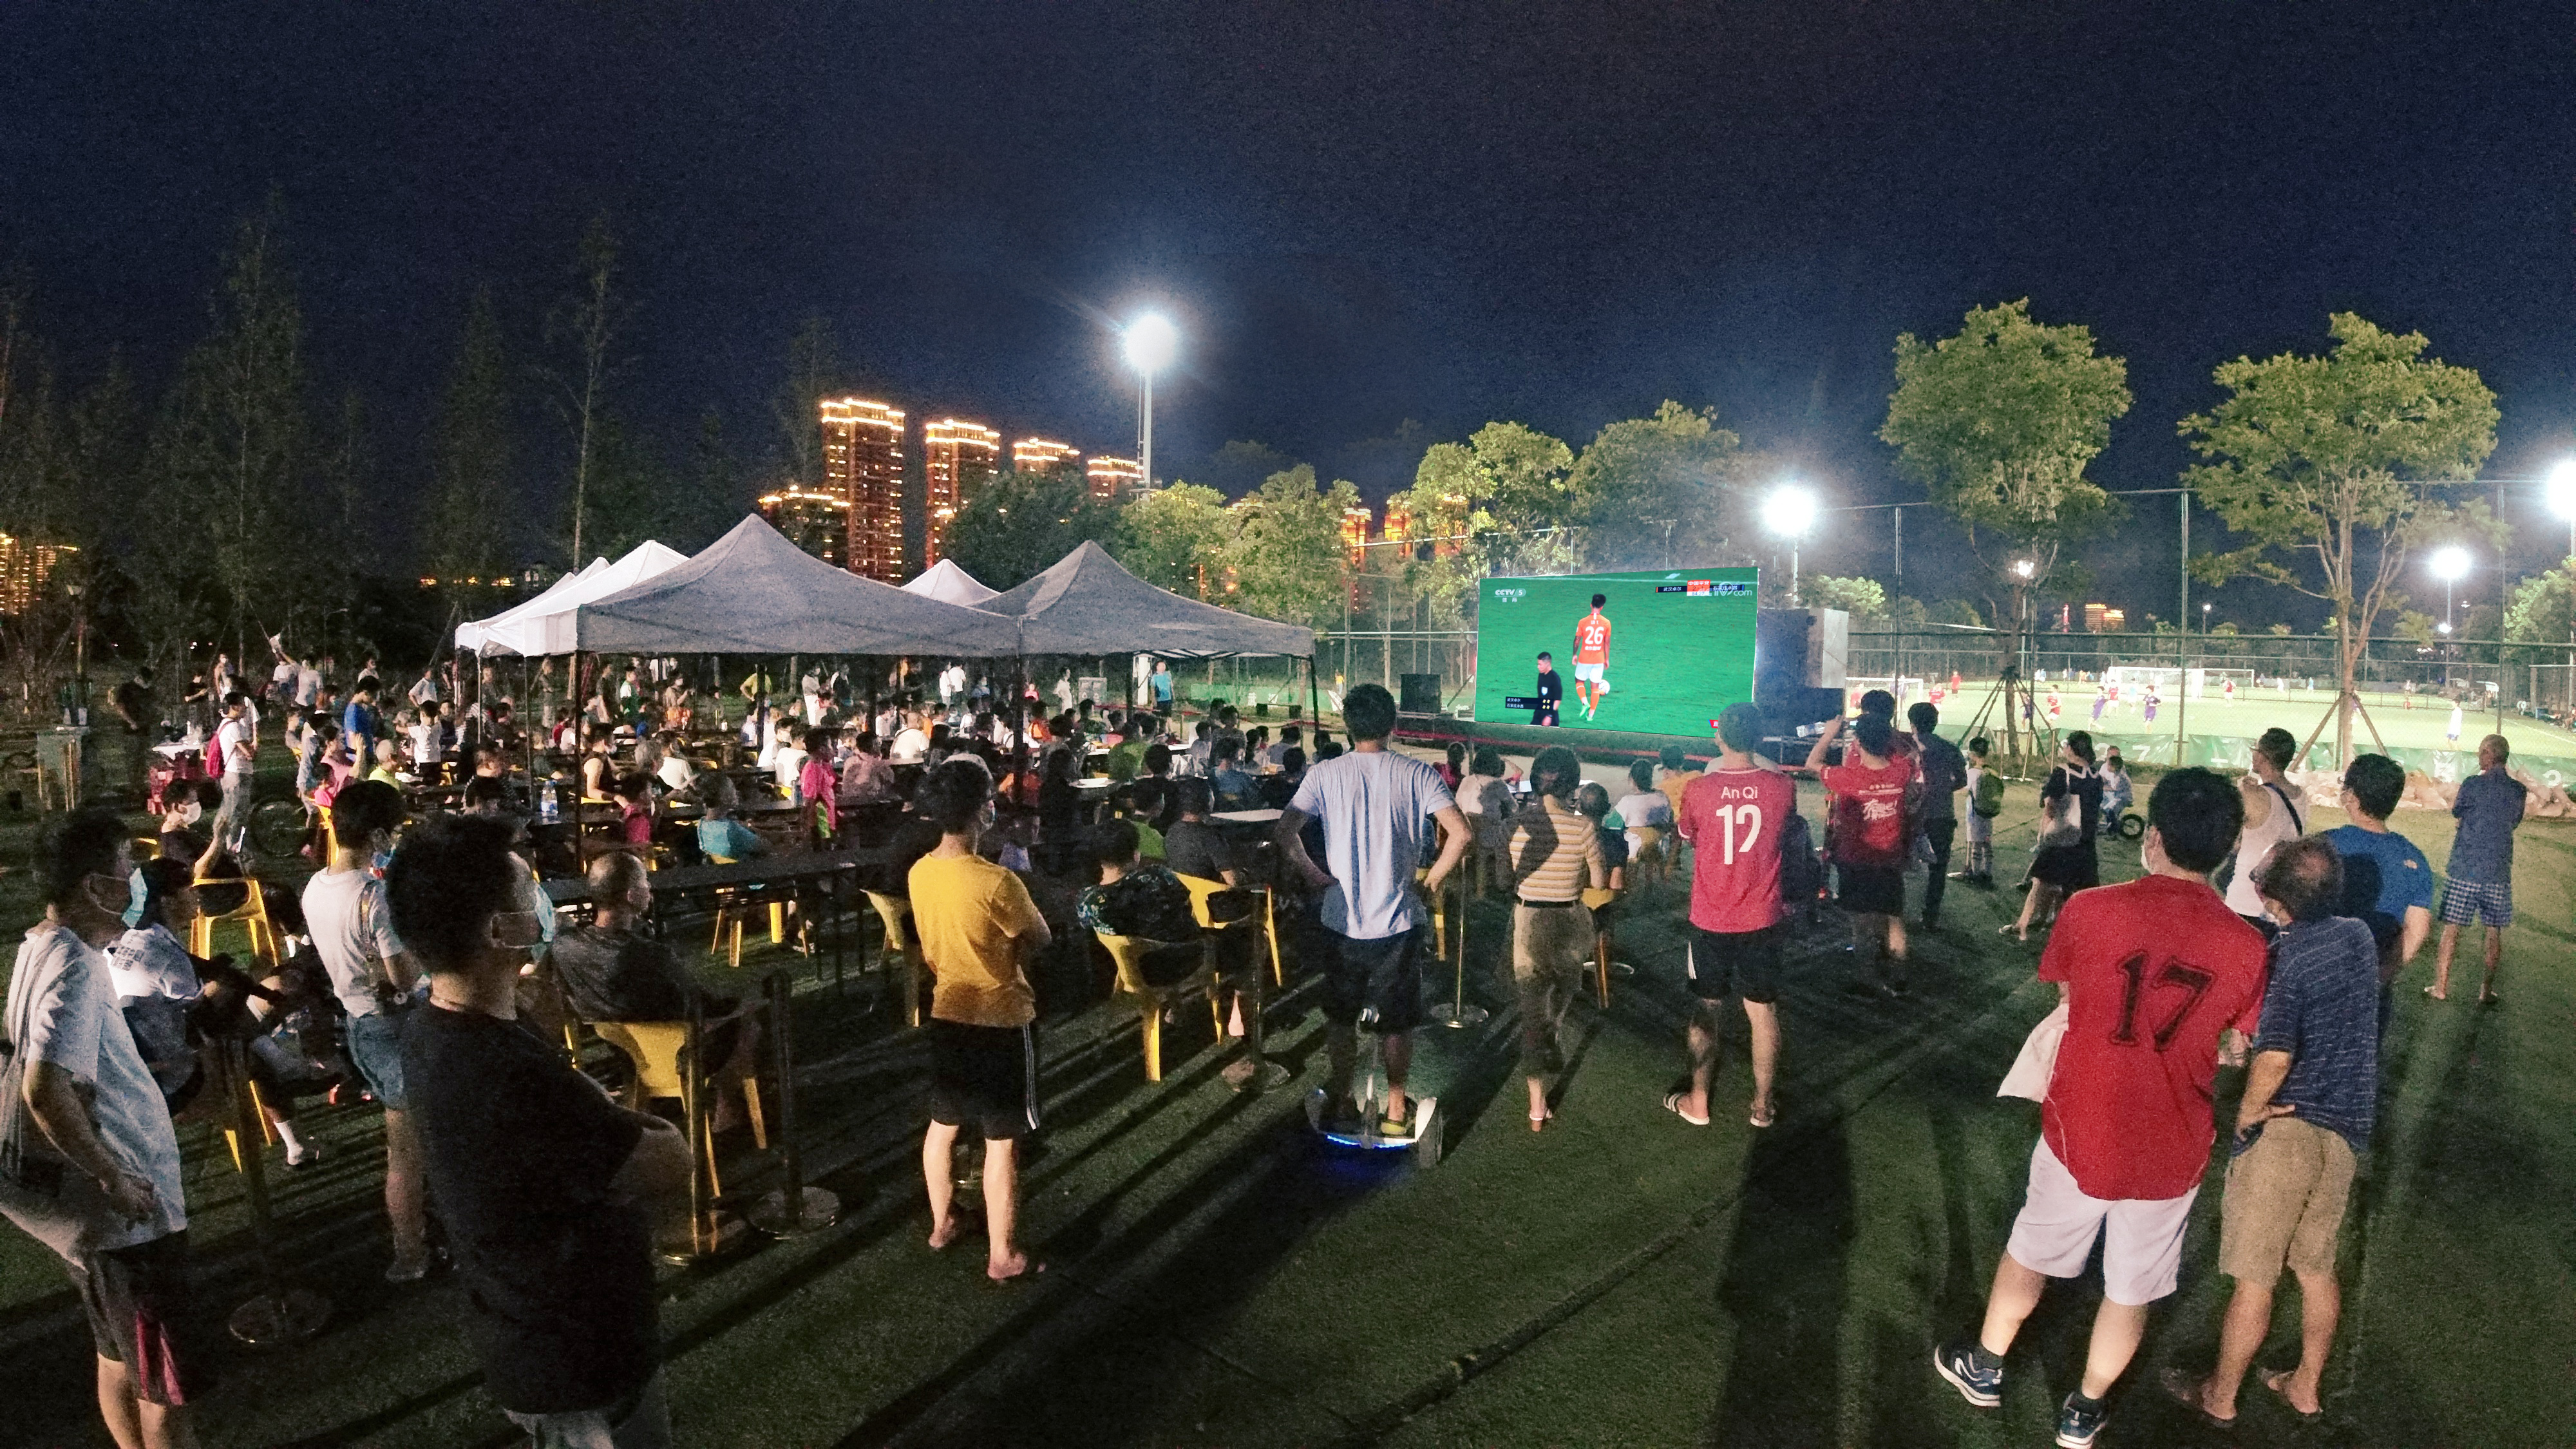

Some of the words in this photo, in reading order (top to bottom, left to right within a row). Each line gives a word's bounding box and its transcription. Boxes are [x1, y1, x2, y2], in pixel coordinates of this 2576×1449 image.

[1585, 626, 1604, 645] 26
[1721, 786, 1740, 799] An
[1742, 786, 1758, 799] Qi
[2109, 949, 2217, 1052] 17
